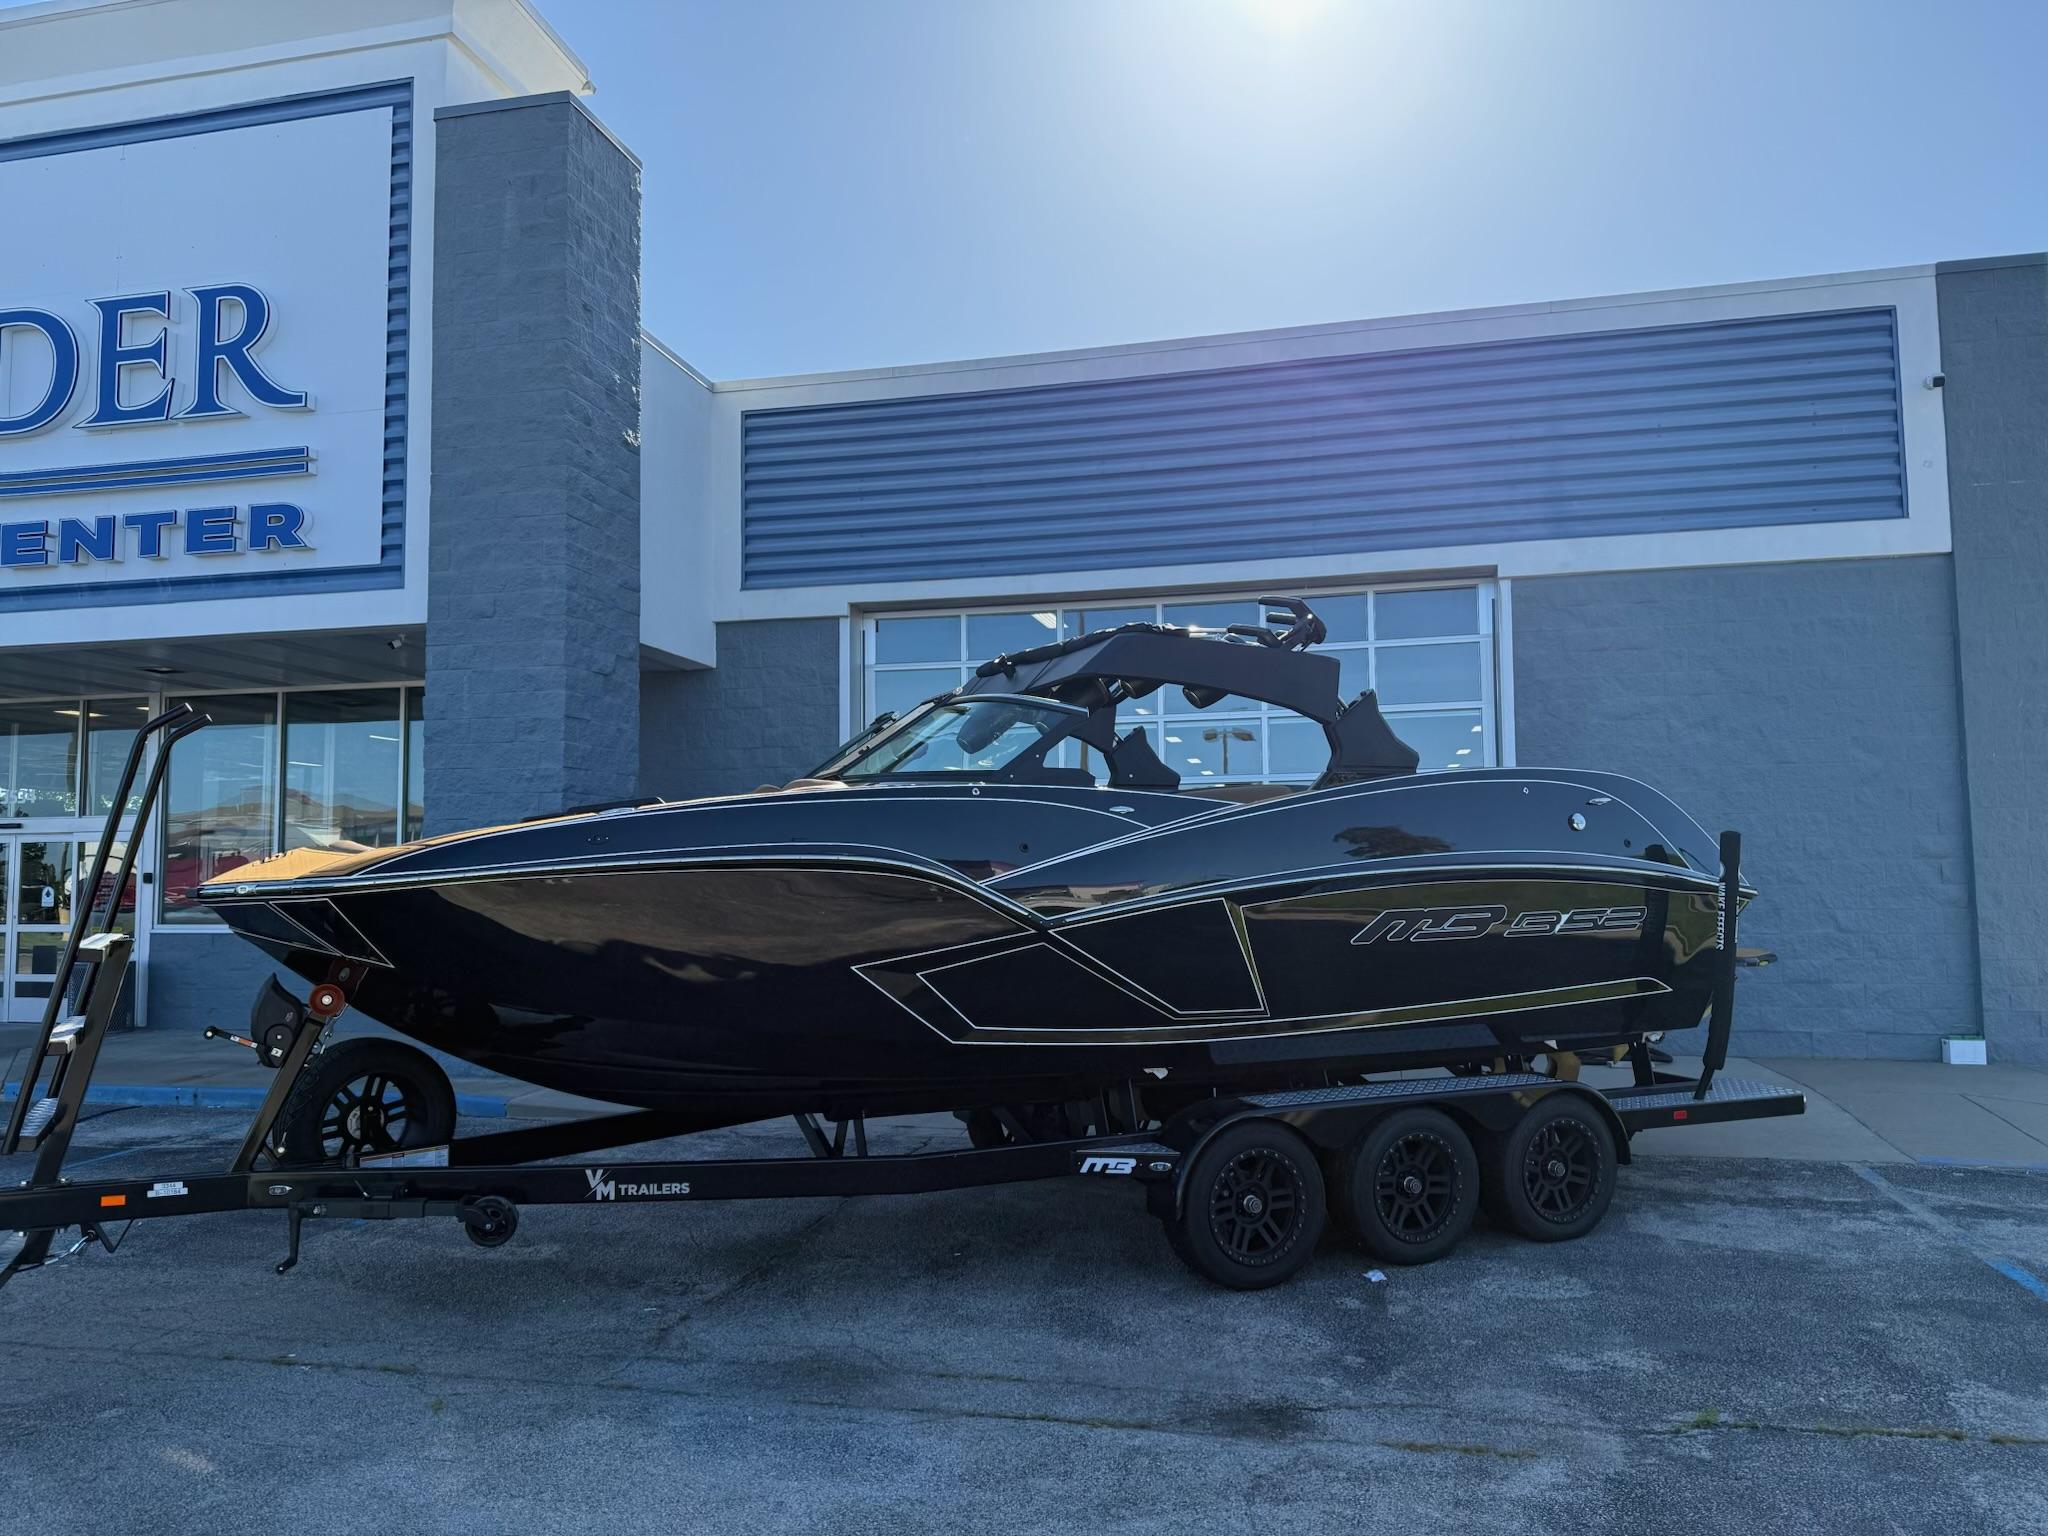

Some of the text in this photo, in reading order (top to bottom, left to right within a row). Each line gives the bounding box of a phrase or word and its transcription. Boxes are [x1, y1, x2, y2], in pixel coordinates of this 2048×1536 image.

[0, 504, 310, 568] ENTER
[1718, 882, 1726, 909] WAKE
[618, 1183, 690, 1196] TRAILERS
